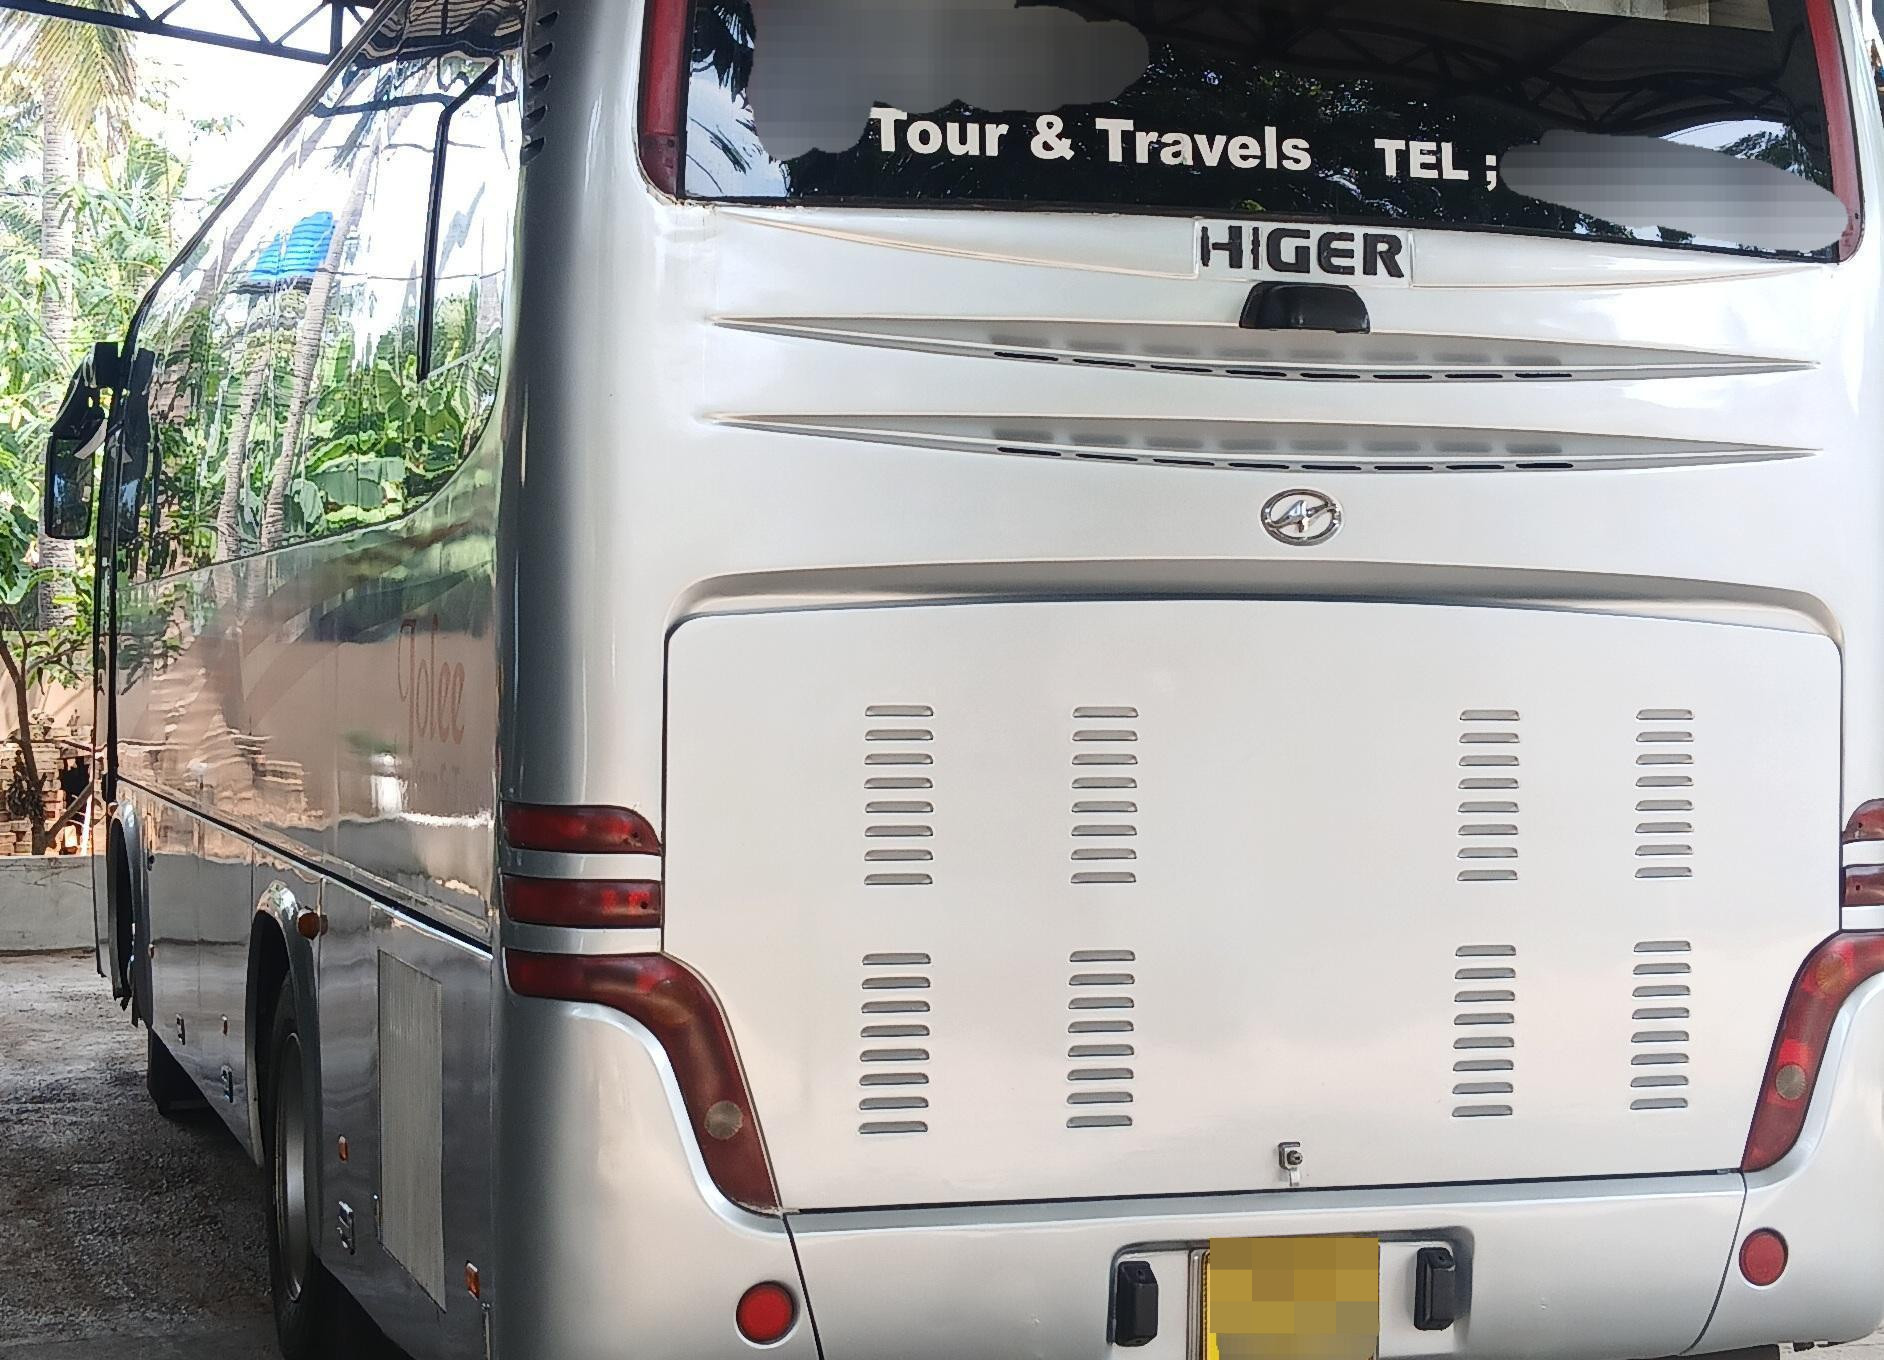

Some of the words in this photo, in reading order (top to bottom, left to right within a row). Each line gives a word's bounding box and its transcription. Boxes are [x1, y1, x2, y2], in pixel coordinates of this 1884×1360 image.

[869, 106, 1009, 157] Tour
[1030, 114, 1075, 161] &
[1095, 117, 1312, 172] Travels
[1374, 138, 1470, 181] TEL
[1201, 225, 1405, 279] HIGER
